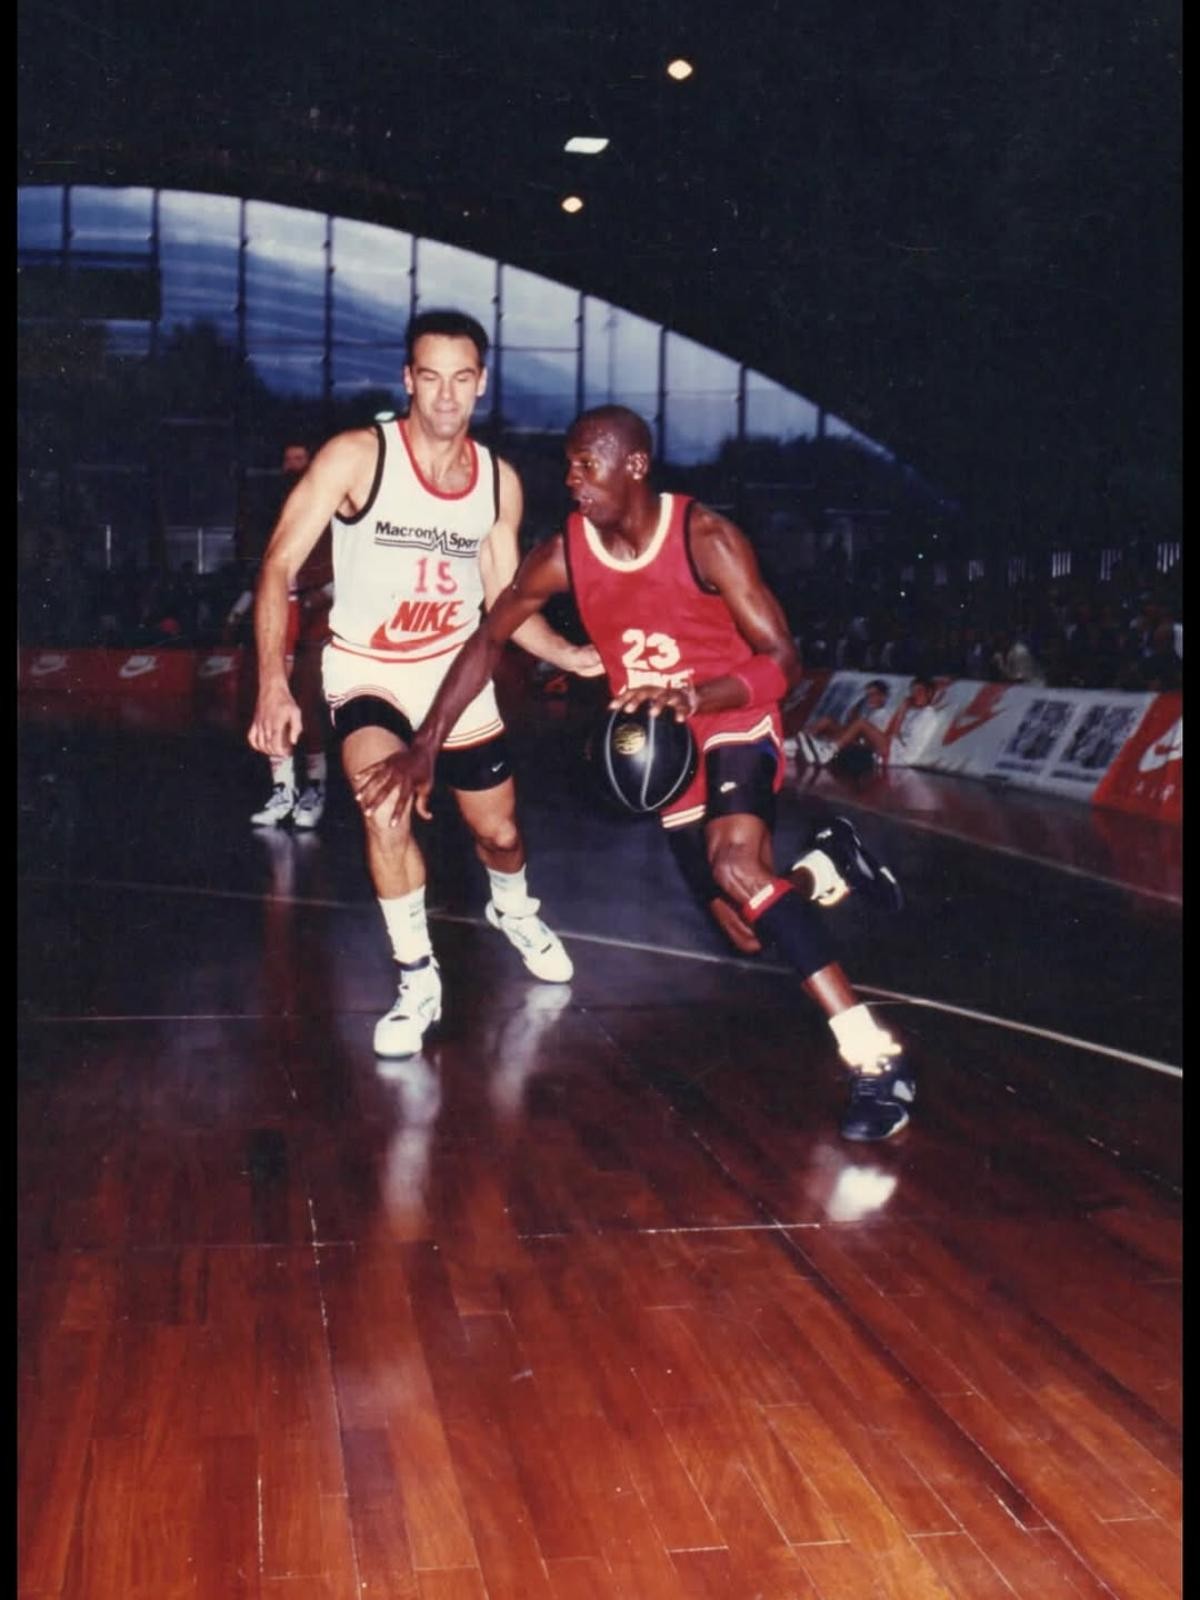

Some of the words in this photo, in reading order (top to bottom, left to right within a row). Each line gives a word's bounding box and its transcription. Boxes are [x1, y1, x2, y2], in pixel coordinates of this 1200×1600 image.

[375, 520, 432, 539] Macron
[415, 556, 458, 595] 15
[390, 600, 464, 632] NIKE
[622, 628, 680, 670] 23
